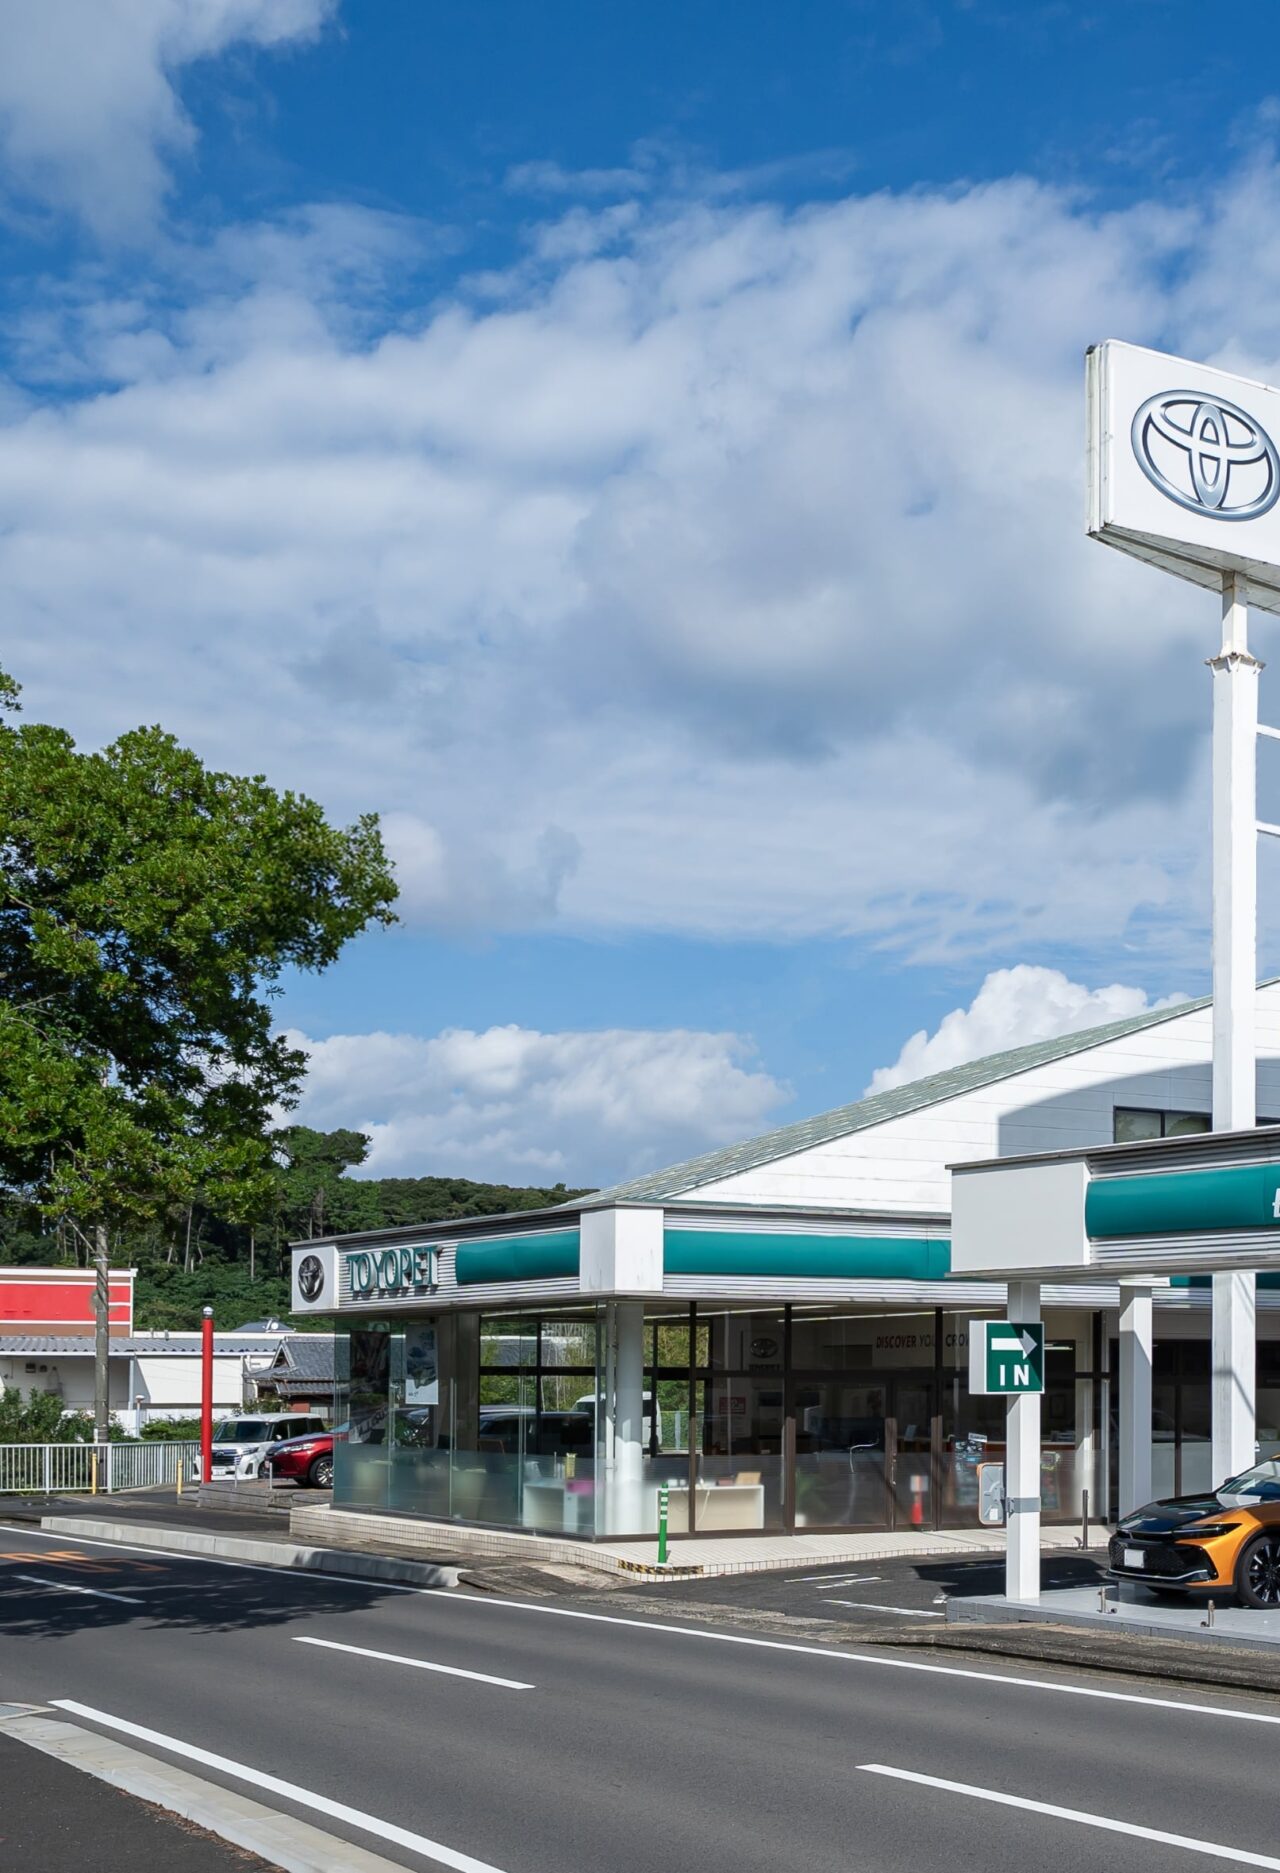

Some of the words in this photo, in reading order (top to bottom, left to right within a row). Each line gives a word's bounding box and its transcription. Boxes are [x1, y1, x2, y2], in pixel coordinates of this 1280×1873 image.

[345, 1245, 439, 1292] TOYOPET
[876, 1335, 917, 1349] DISCOVER
[1000, 1364, 1030, 1386] IN
